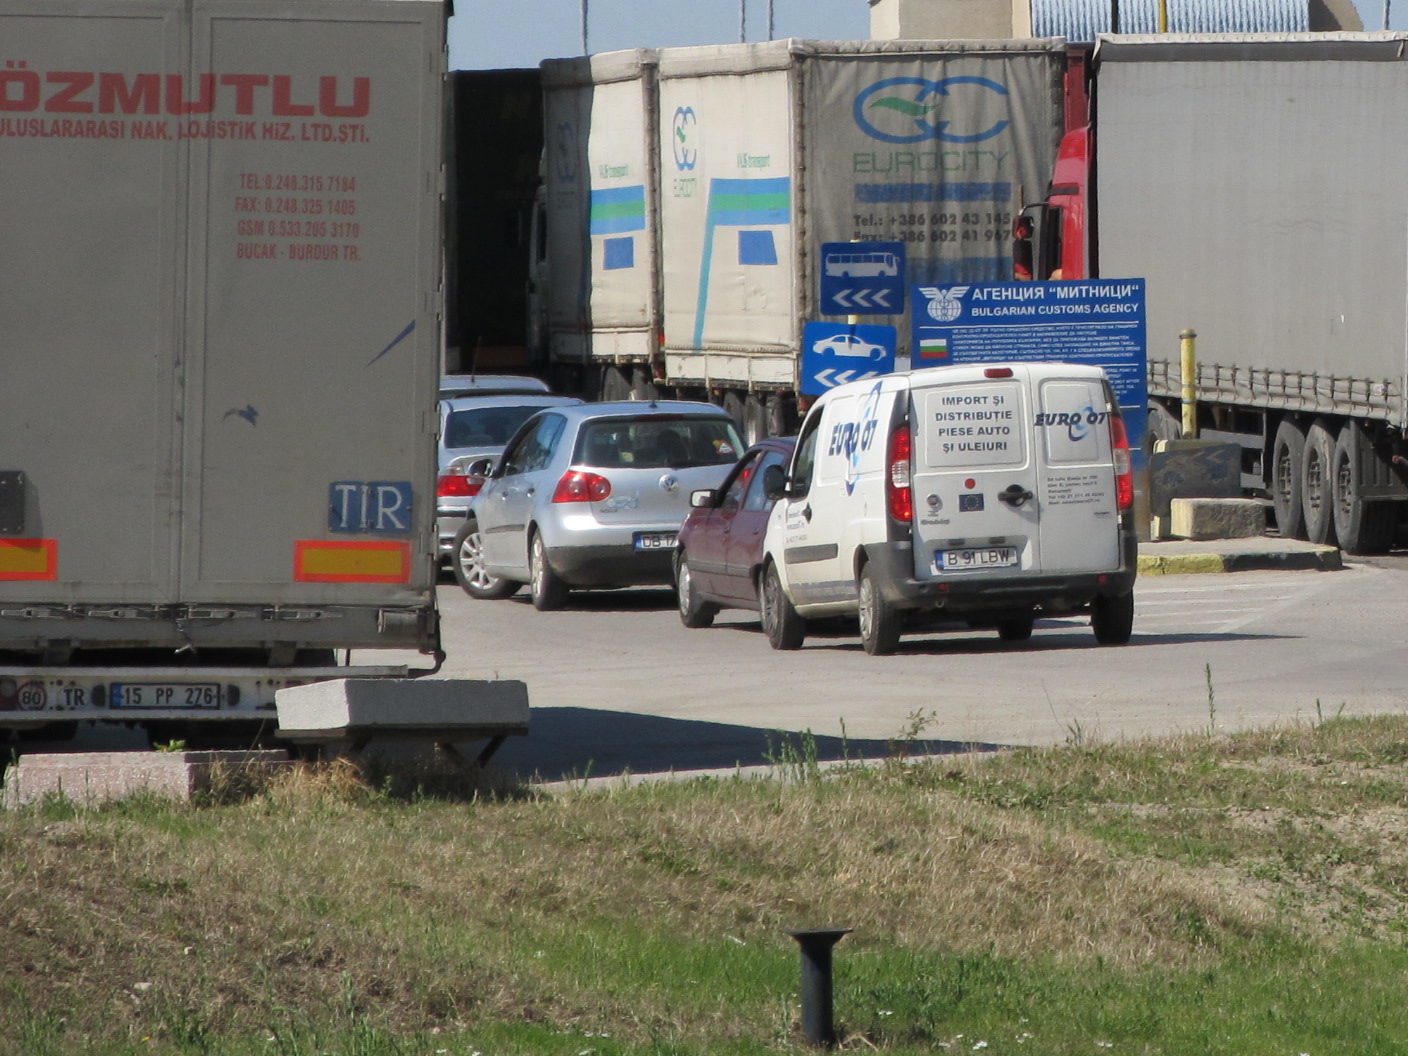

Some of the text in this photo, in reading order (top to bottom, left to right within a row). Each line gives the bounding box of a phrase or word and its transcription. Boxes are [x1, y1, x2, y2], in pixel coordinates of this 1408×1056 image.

[0, 60, 370, 118] ÖZMUTLU
[853, 151, 1009, 173] EUROCITY
[889, 214, 926, 226] +386
[930, 213, 956, 225] 602
[962, 213, 979, 225] 43
[930, 230, 956, 242] 602
[972, 286, 1045, 302] АГЕНЦИЯ
[971, 303, 1139, 317] BULGARIAN CUSTOMS AGENCY
[942, 396, 989, 406] IMPORT
[1034, 411, 1108, 427] EURO 07
[938, 426, 1010, 437] PIESE AUTO
[958, 442, 1007, 451] ULEIURI
[335, 484, 405, 529] TIR
[948, 549, 1009, 565] B 91 LBW
[22, 691, 41, 705] 80
[64, 689, 85, 706] TR
[125, 688, 213, 705] 15 PP 276
